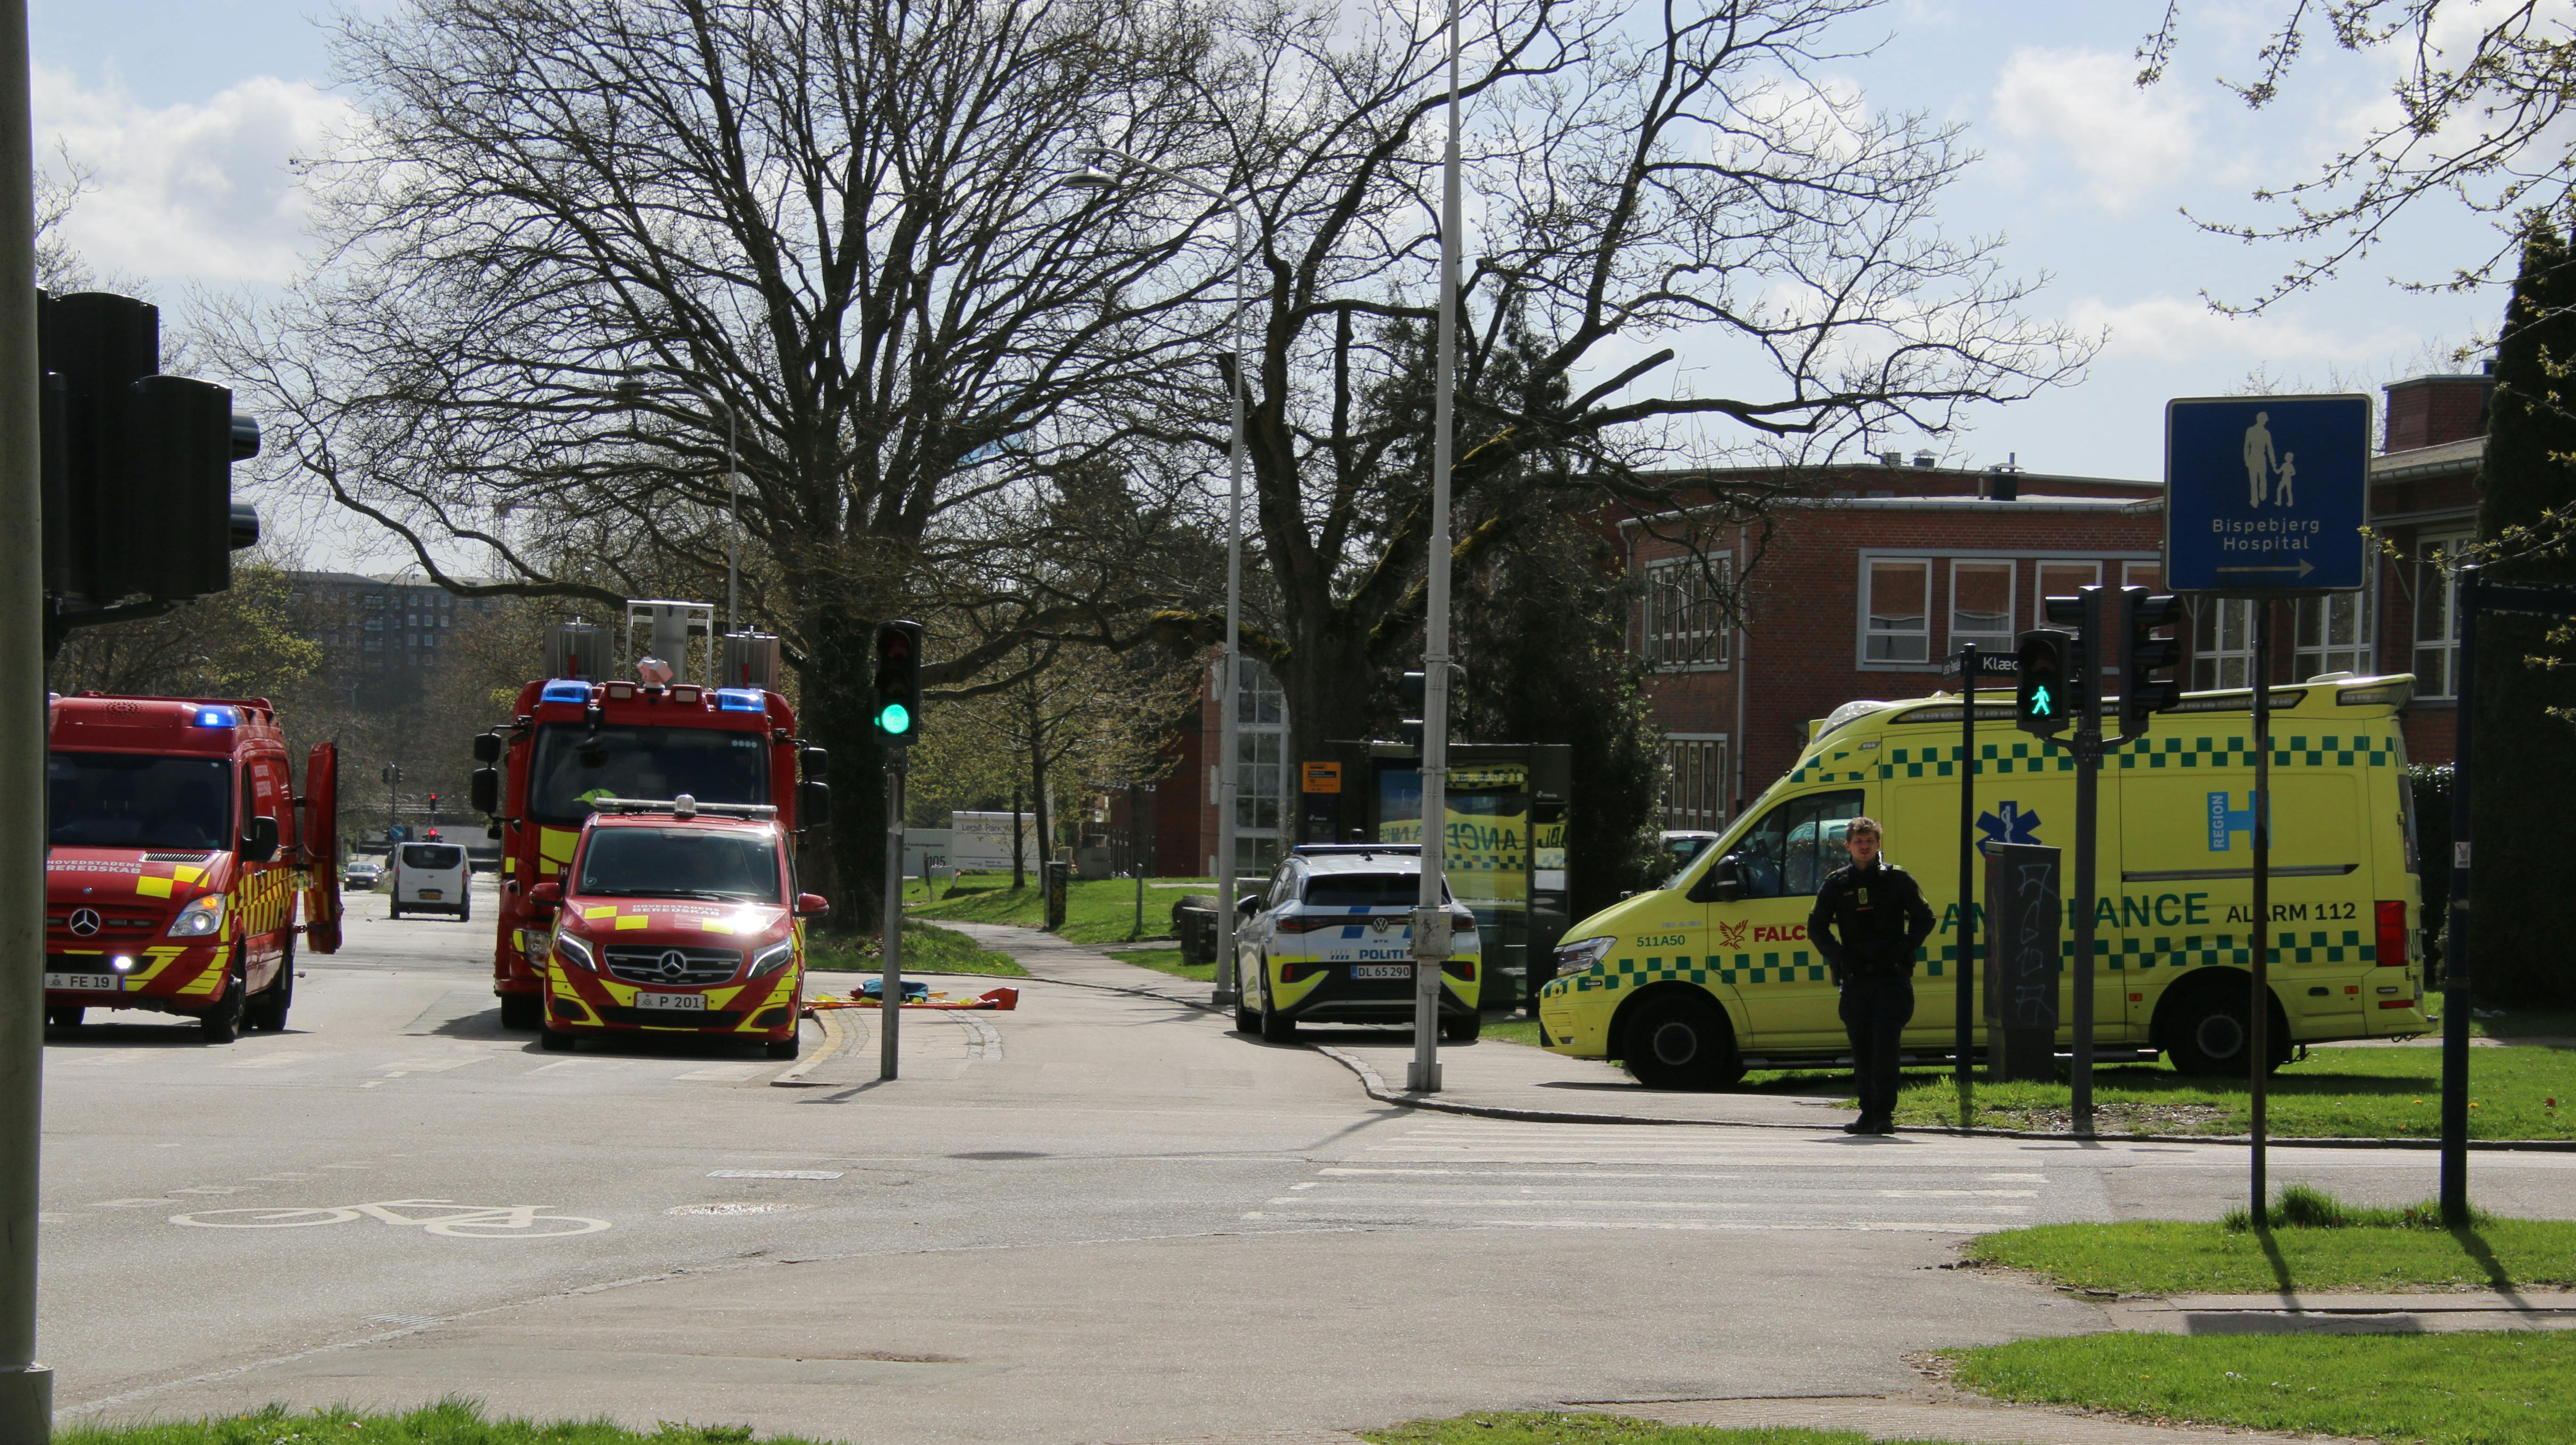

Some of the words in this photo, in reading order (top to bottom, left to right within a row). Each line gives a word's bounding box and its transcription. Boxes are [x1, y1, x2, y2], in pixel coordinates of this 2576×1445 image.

[2213, 518, 2319, 534] Bispebjerg
[2223, 536, 2309, 552] Hospital
[962, 823, 982, 831] Lersø
[985, 824, 1001, 832] Park
[2212, 795, 2224, 848] REGION
[48, 860, 143, 868] HOVEDSTADENS
[632, 908, 720, 916] BEREDSKAB
[2226, 904, 2307, 923] ALRM
[2314, 902, 2356, 920] 112
[1754, 925, 1811, 942] FALC
[1636, 935, 1685, 947] 511A50
[1359, 949, 1404, 960] POLITI
[1359, 967, 1372, 977] DL
[1375, 967, 1387, 977] 65
[1390, 967, 1409, 977] 290
[71, 976, 88, 987] FE
[94, 977, 109, 988] 19
[660, 996, 669, 1007] P
[675, 996, 700, 1008] 201
